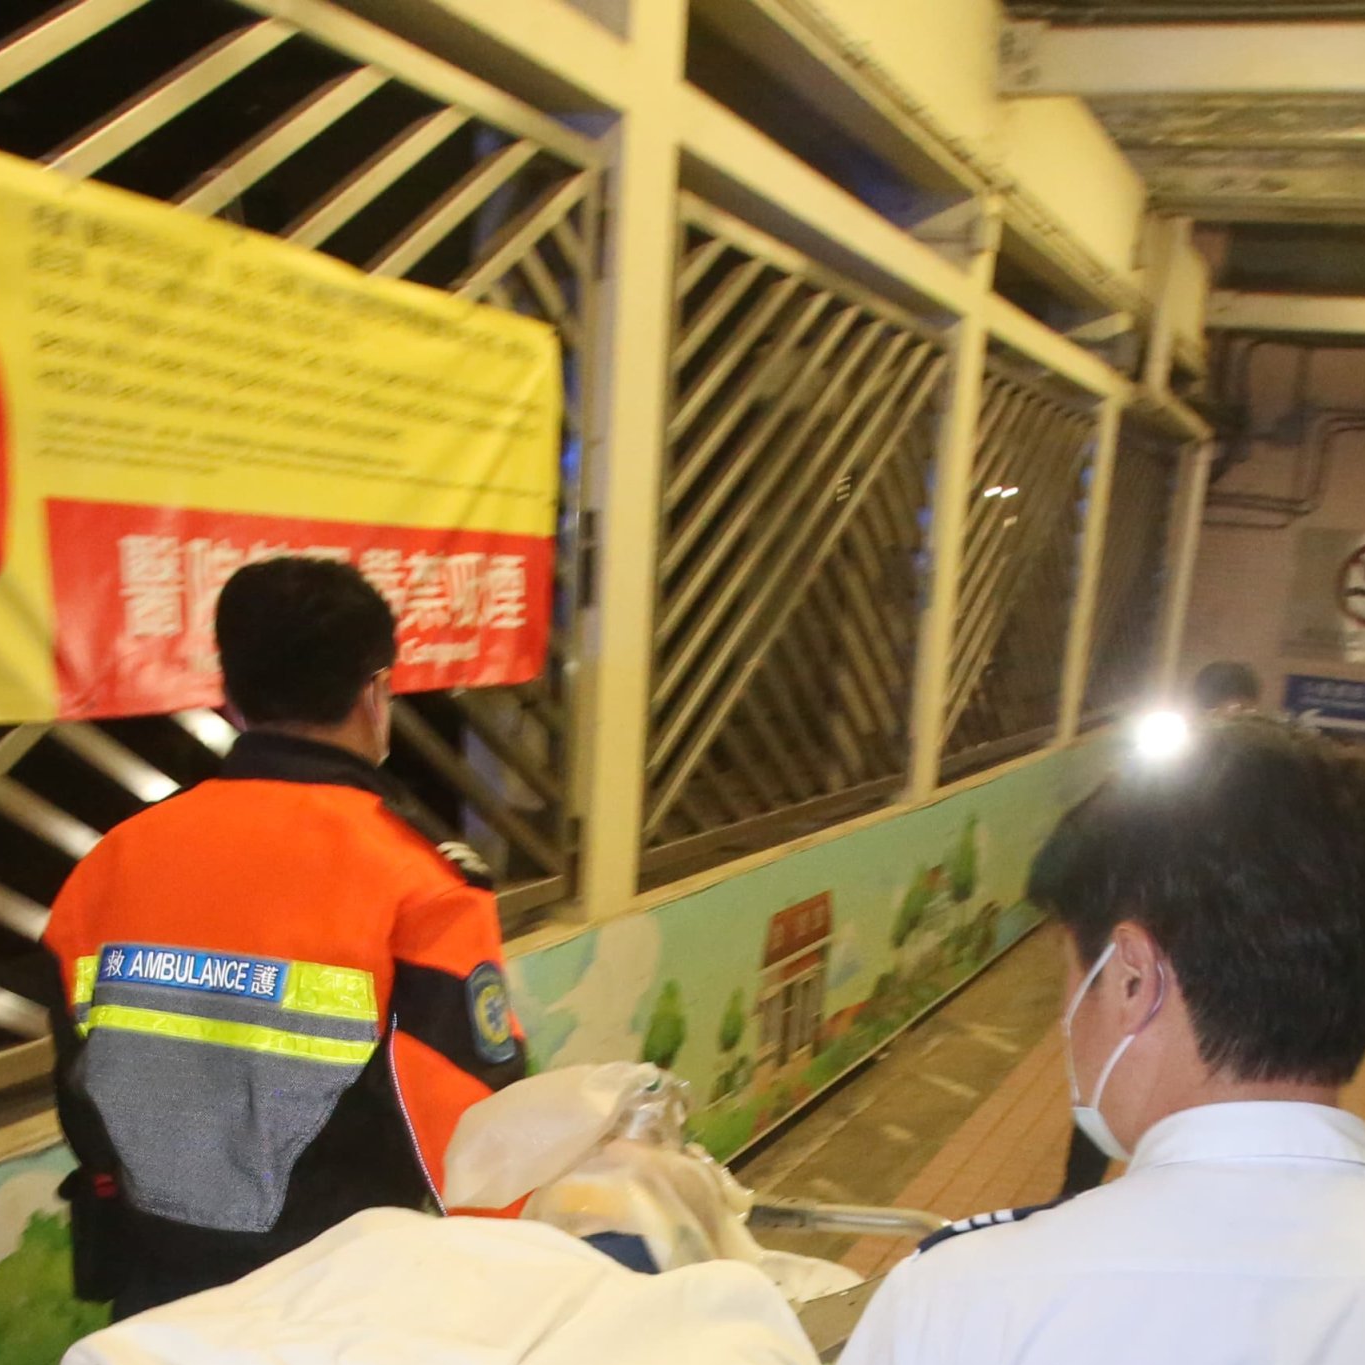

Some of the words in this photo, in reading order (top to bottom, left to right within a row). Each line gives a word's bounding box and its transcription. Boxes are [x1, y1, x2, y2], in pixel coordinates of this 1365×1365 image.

[106, 949, 125, 977] 救
[128, 950, 251, 991] AMBULANCE
[250, 963, 280, 997] 護
